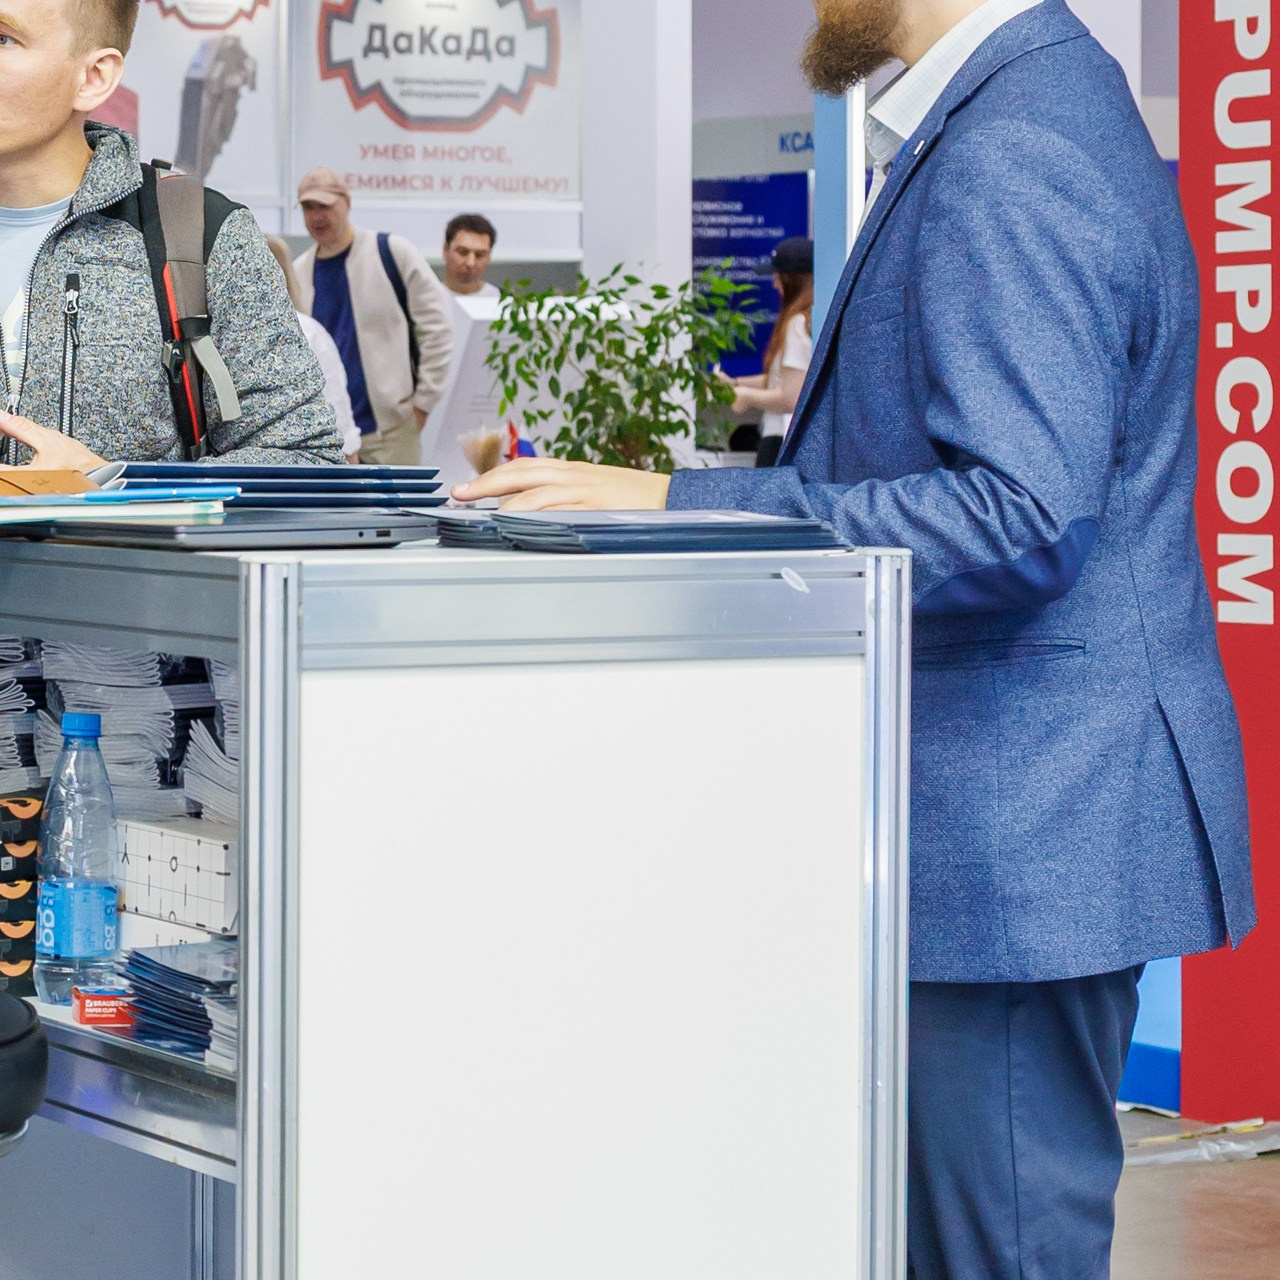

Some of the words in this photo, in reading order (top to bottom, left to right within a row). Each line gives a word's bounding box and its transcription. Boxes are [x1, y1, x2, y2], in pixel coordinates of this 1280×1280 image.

[363, 23, 516, 63] ДаКаДа
[359, 143, 416, 161] УМЕЯ
[423, 145, 513, 164] МНОГОЕ,
[459, 175, 570, 195] ЛУЧШЕМУ!
